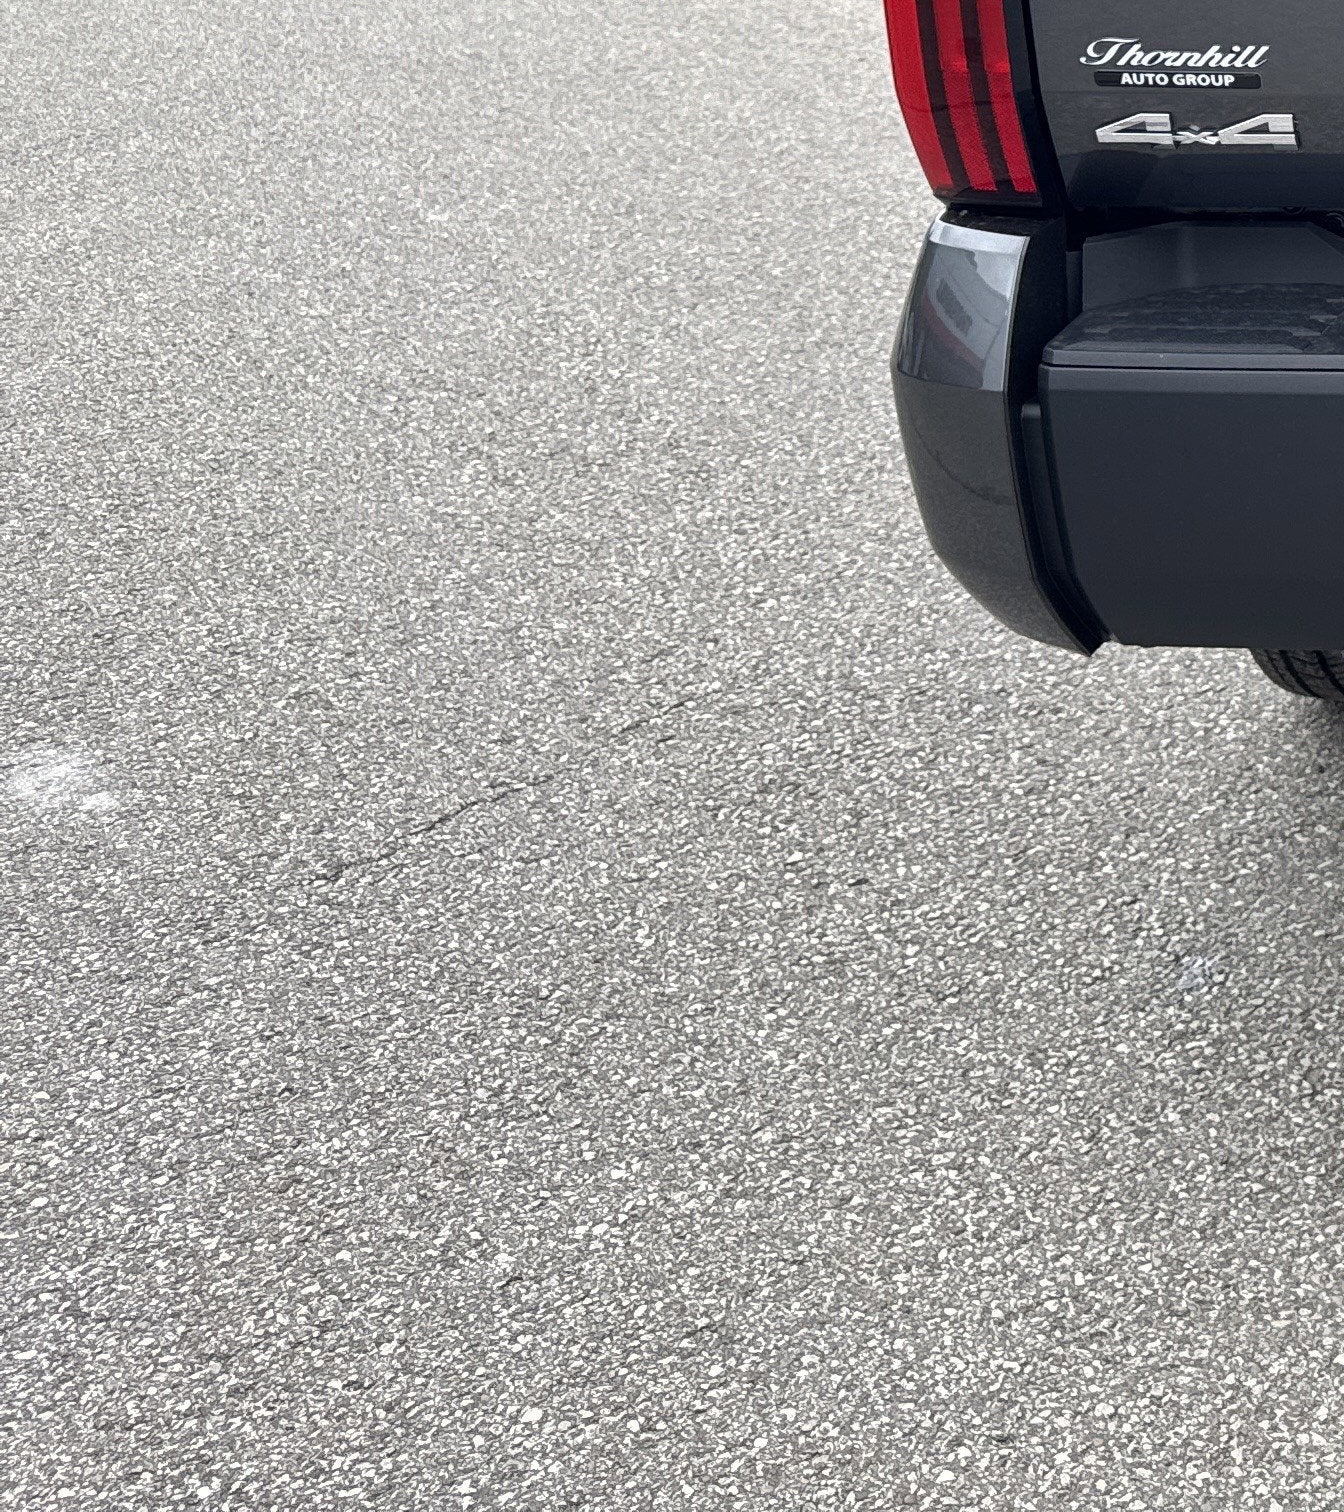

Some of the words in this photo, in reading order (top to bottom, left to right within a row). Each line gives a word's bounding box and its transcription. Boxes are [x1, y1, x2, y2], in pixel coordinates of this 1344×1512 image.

[1079, 36, 1270, 68] Thornhill
[1120, 72, 1169, 86] AUTO
[1172, 73, 1236, 87] GROUP
